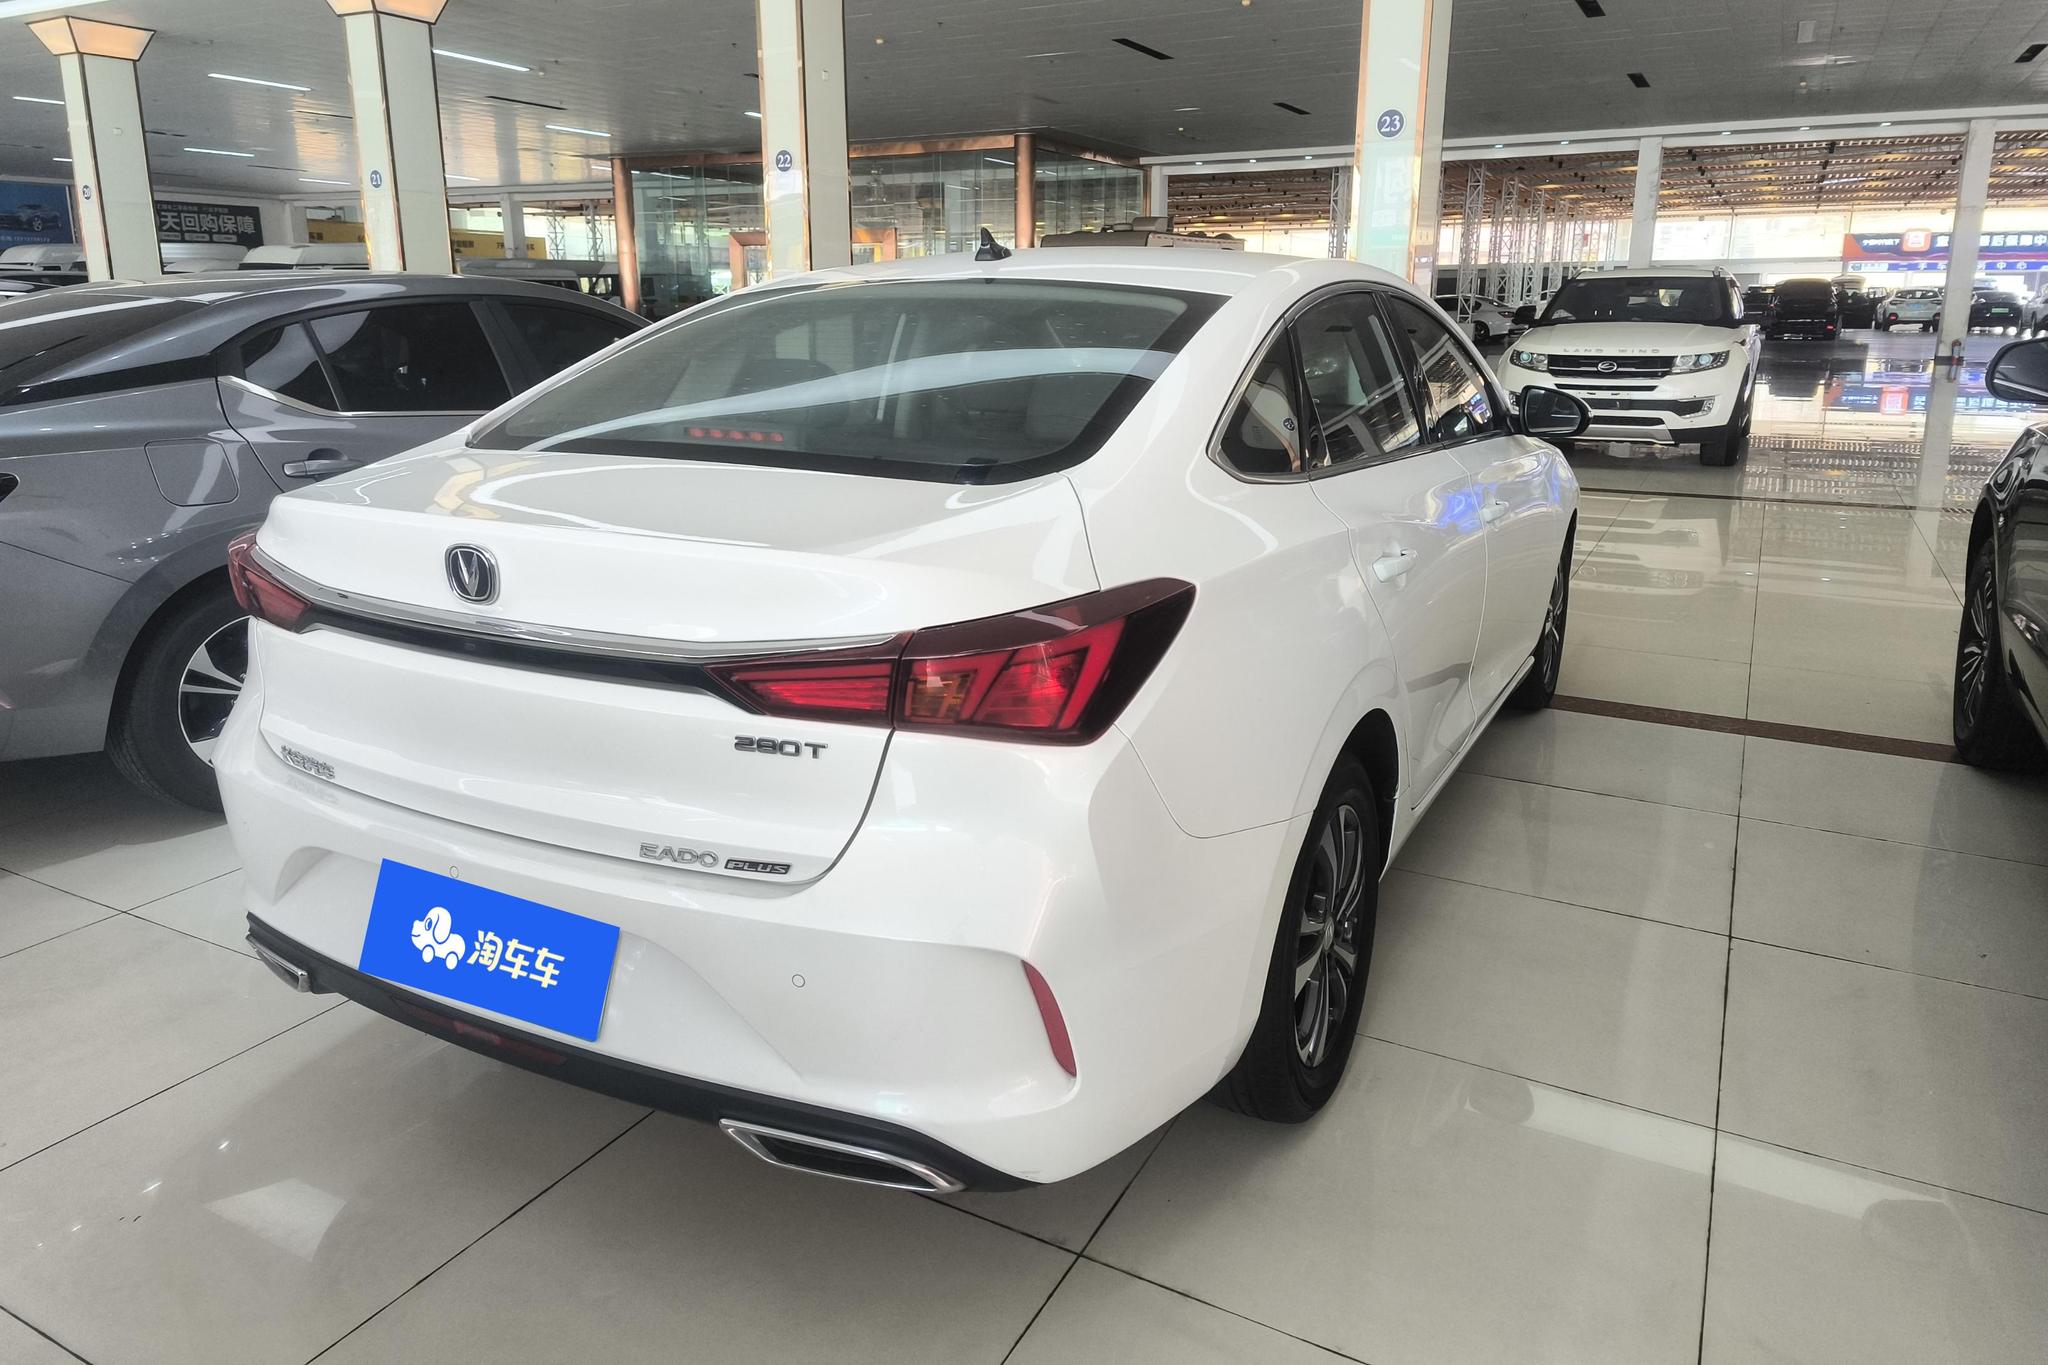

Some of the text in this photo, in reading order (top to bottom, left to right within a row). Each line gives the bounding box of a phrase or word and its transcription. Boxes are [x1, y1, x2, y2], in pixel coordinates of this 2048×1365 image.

[1380, 115, 1401, 132] 23
[777, 154, 791, 168] 22
[371, 174, 381, 185] 21
[156, 211, 256, 234] 天回购保障
[733, 735, 829, 760] 280T
[639, 842, 790, 875] EADO PLUS
